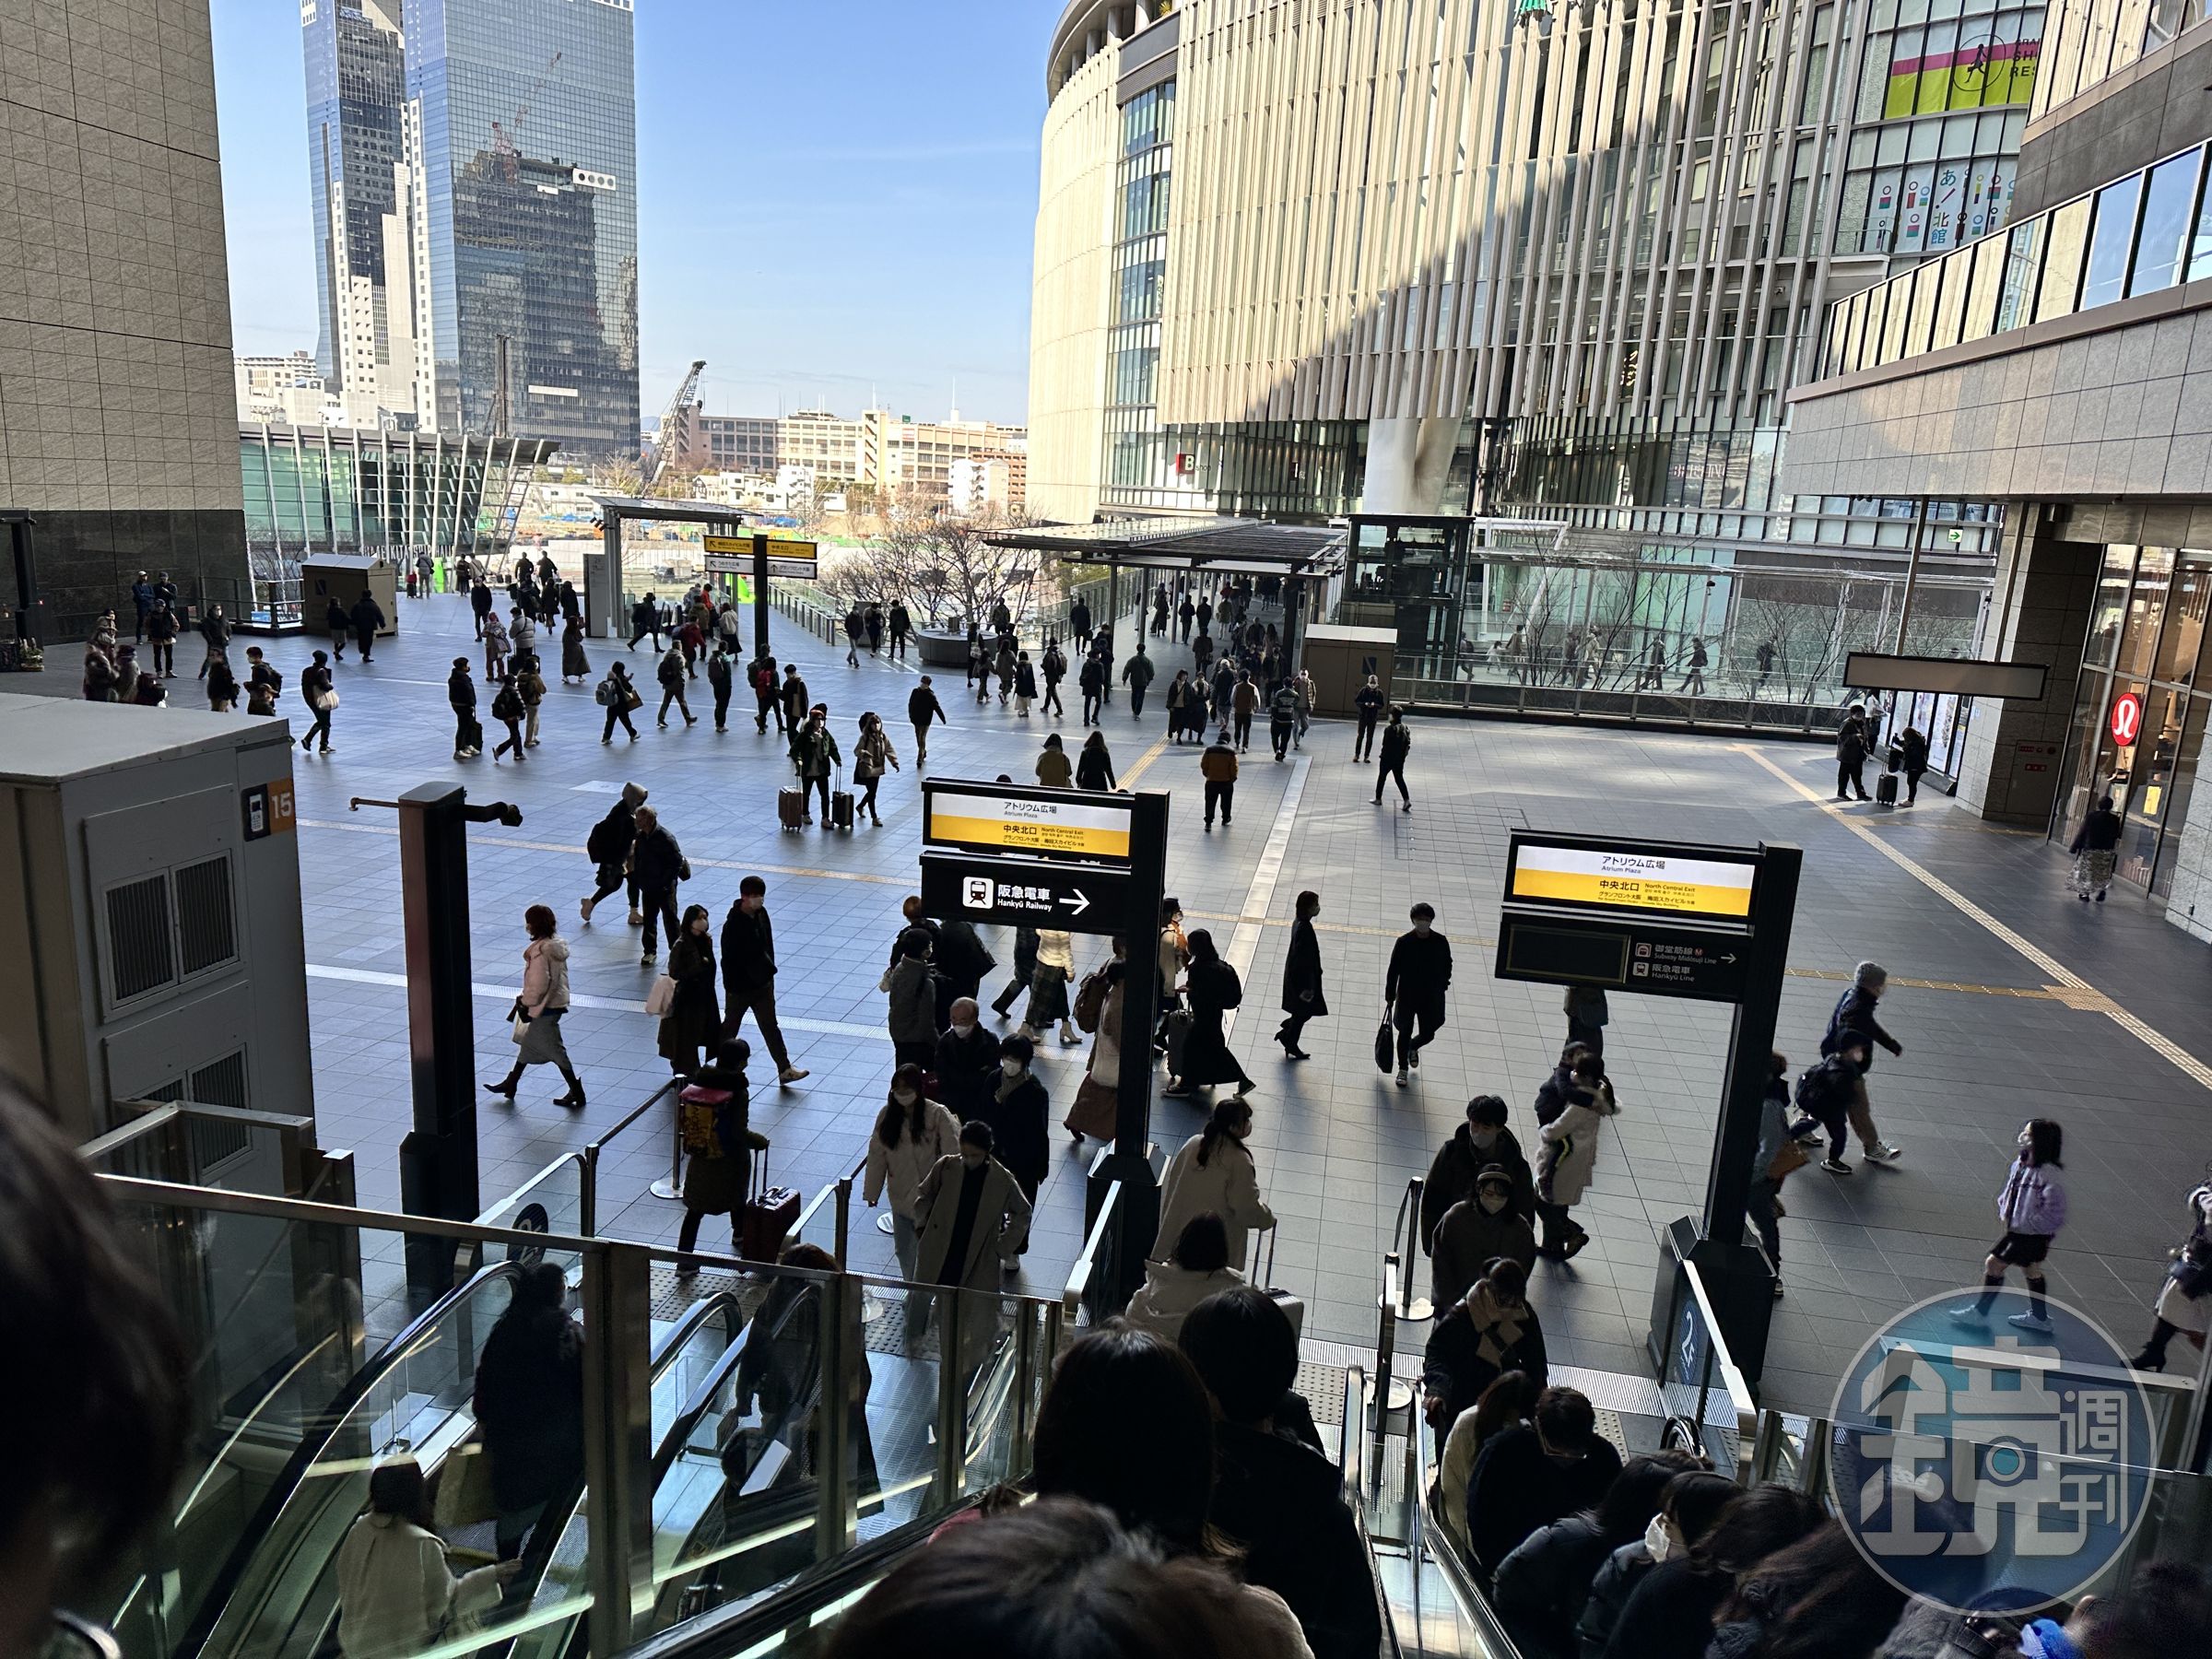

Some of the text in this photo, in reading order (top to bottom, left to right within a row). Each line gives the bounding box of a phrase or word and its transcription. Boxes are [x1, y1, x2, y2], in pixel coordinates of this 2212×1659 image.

[2015, 38, 2041, 46] GRA
[2013, 51, 2038, 62] SH
[271, 792, 291, 818] 15
[1004, 802, 1057, 814] アトリウム広場
[1003, 824, 1037, 835] 中央北口
[1602, 855, 1665, 869] アトリウム広場
[1599, 880, 1640, 891] 中央北口
[998, 884, 1051, 901] 阪急電車
[1025, 900, 1053, 912] Railway
[1654, 952, 1677, 961] Subway
[1652, 963, 1690, 974] 阪急電車
[1679, 974, 1695, 982] Line
